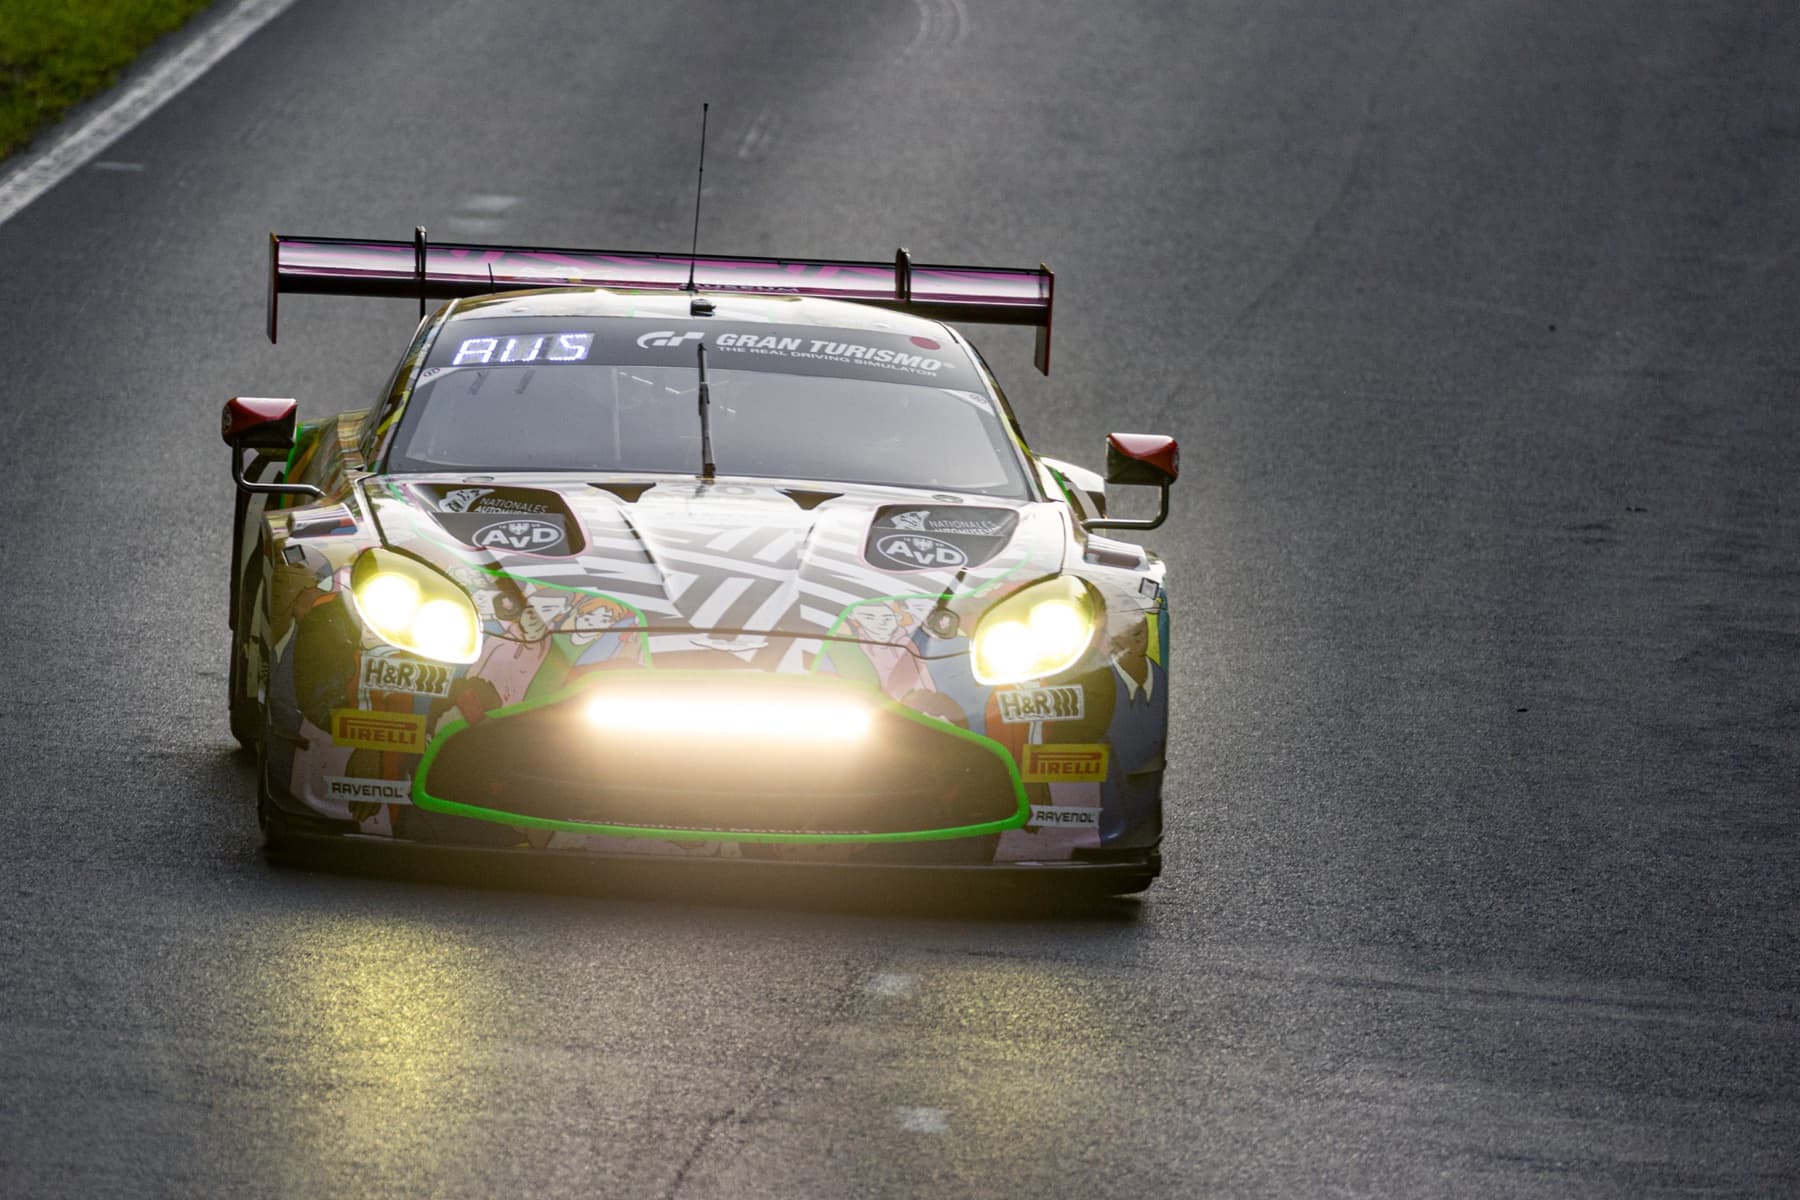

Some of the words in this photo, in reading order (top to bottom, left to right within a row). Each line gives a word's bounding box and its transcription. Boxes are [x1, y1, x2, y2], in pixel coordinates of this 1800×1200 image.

[452, 333, 588, 366] AUS
[716, 333, 802, 350] GRAN
[811, 340, 943, 371] TURISMO
[750, 348, 787, 357] REAL
[796, 352, 850, 363] DRIVING
[854, 359, 938, 377] SIMULATOR
[365, 657, 416, 689] H&R
[1001, 690, 1053, 718] H&R
[338, 716, 419, 745] PIRELLI
[1029, 752, 1103, 775] PIRELLI
[331, 781, 404, 798] RAVENOL
[1036, 811, 1095, 823] RAVENOL
